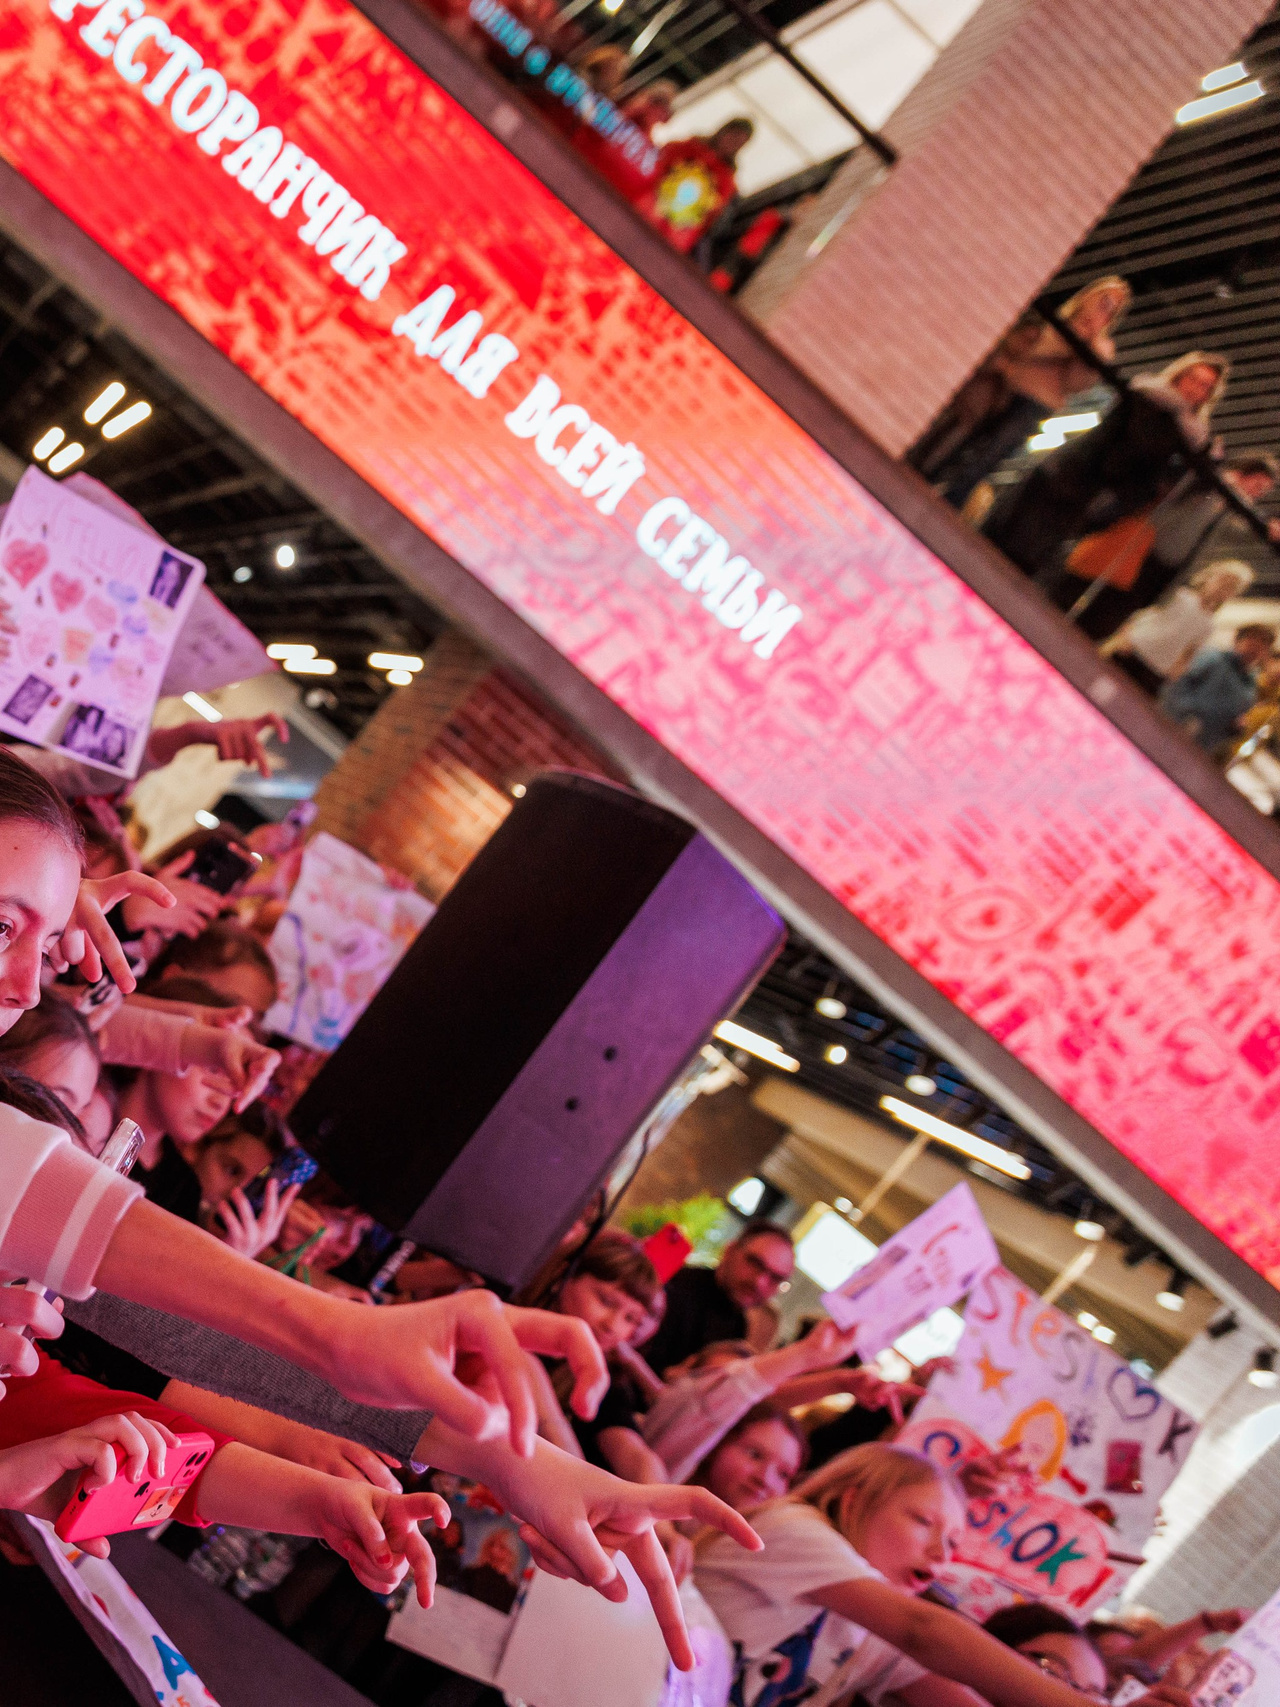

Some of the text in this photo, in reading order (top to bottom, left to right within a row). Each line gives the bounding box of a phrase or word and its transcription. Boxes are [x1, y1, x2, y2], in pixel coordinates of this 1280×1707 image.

[391, 284, 520, 400] ДЛЯ
[503, 374, 647, 517] ВСЕЙ
[634, 495, 805, 662] СЕМЬИ
